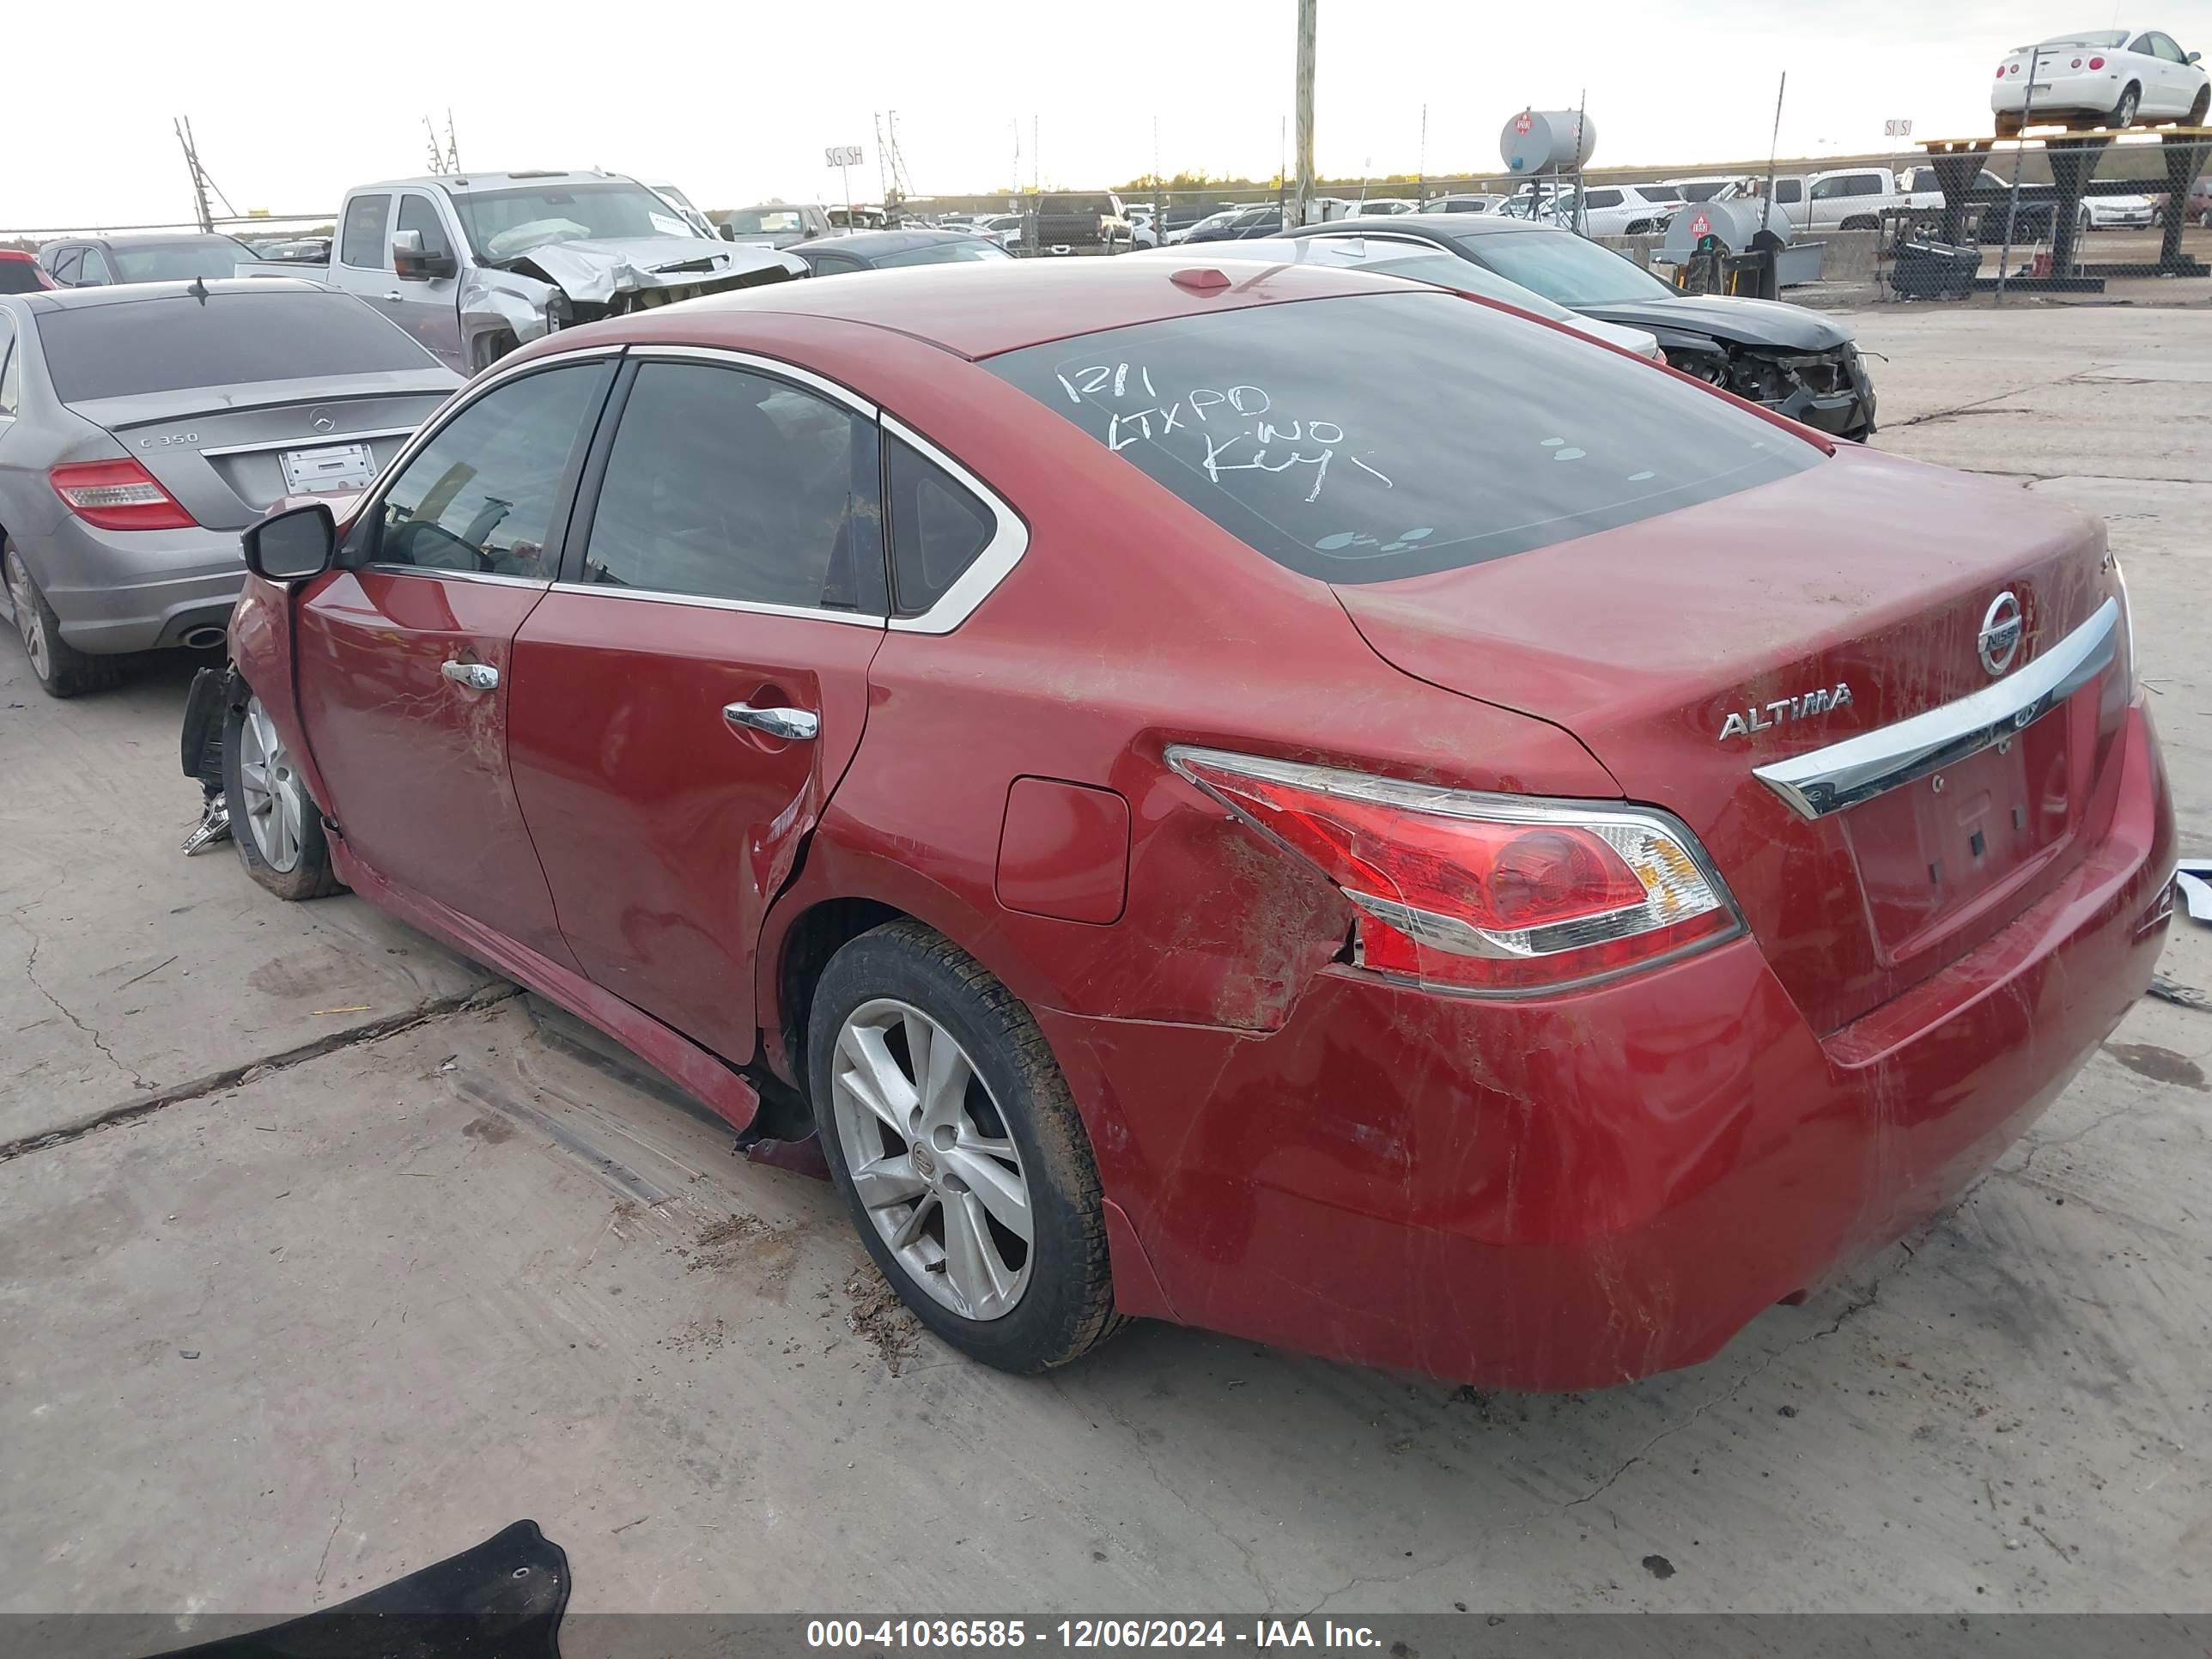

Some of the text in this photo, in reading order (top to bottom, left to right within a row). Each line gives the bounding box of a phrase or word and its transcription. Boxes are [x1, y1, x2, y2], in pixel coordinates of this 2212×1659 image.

[825, 146, 863, 167] SG SH
[140, 432, 200, 448] C 350
[1718, 683, 1853, 741] ALTIMA
